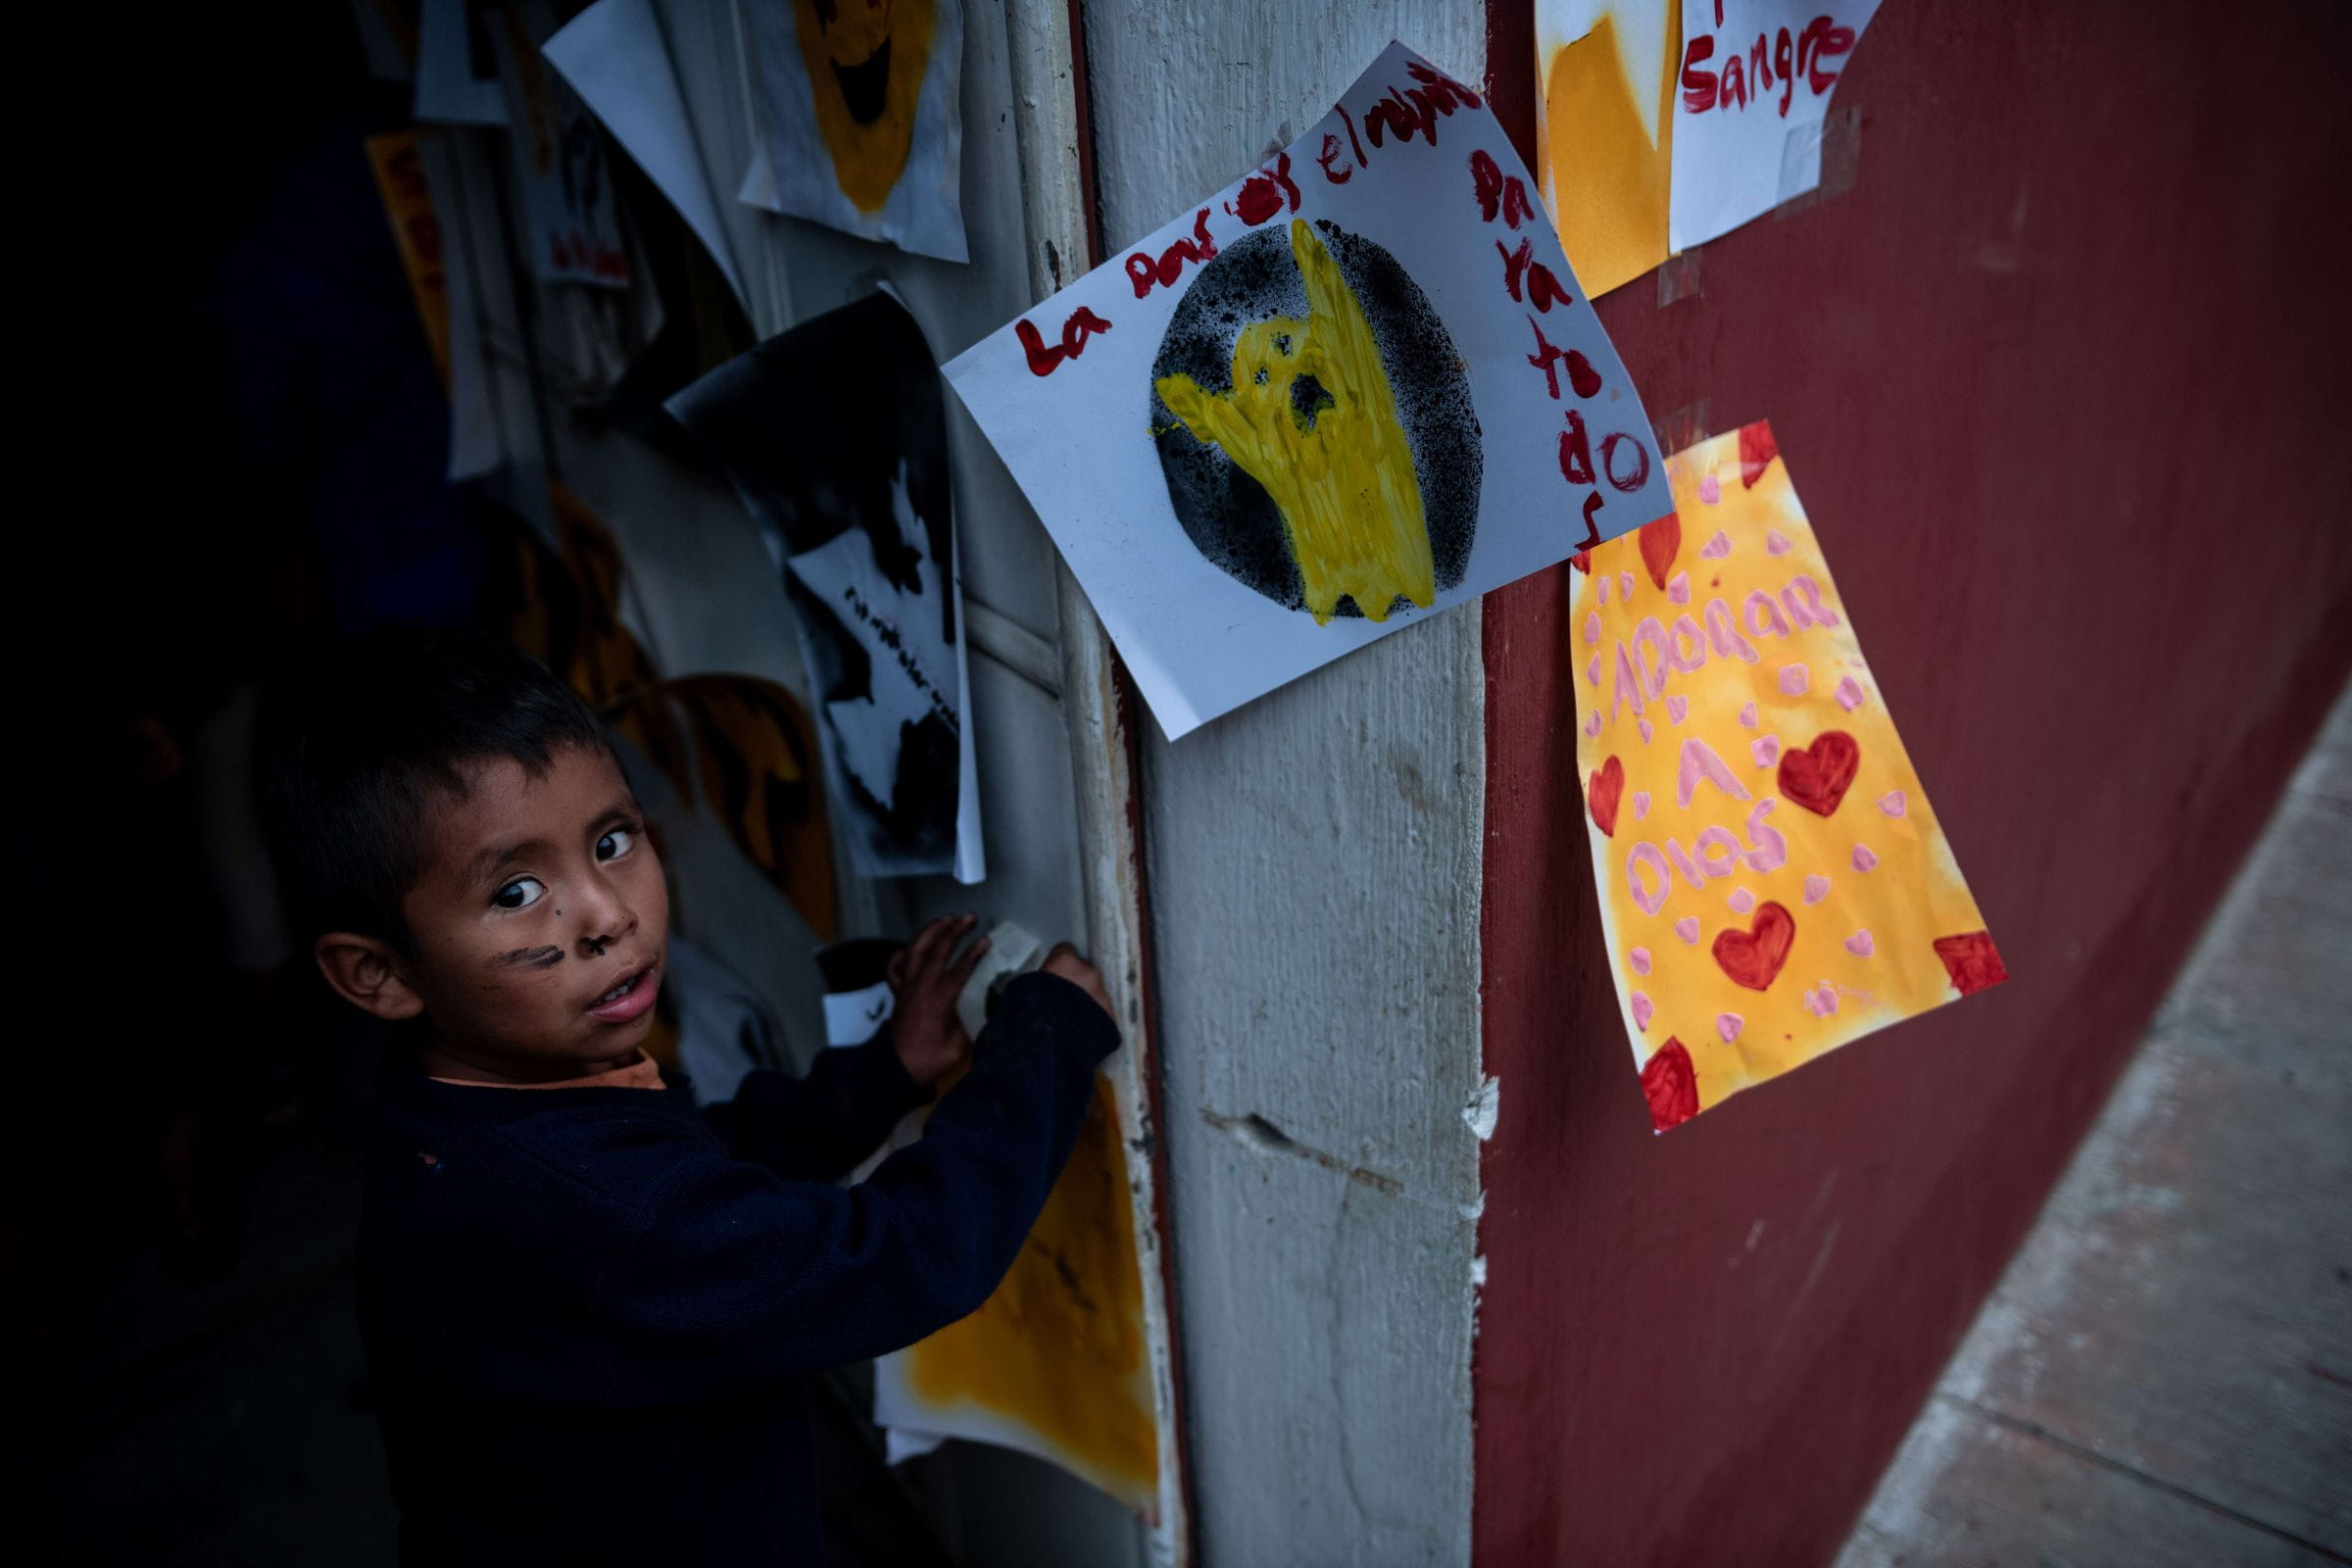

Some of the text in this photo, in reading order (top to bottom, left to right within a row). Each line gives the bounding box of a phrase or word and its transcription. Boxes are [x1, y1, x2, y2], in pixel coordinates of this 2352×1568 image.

[1682, 16, 1855, 118] Sangre
[1016, 307, 1112, 377] La
[1677, 736, 1753, 810] A
